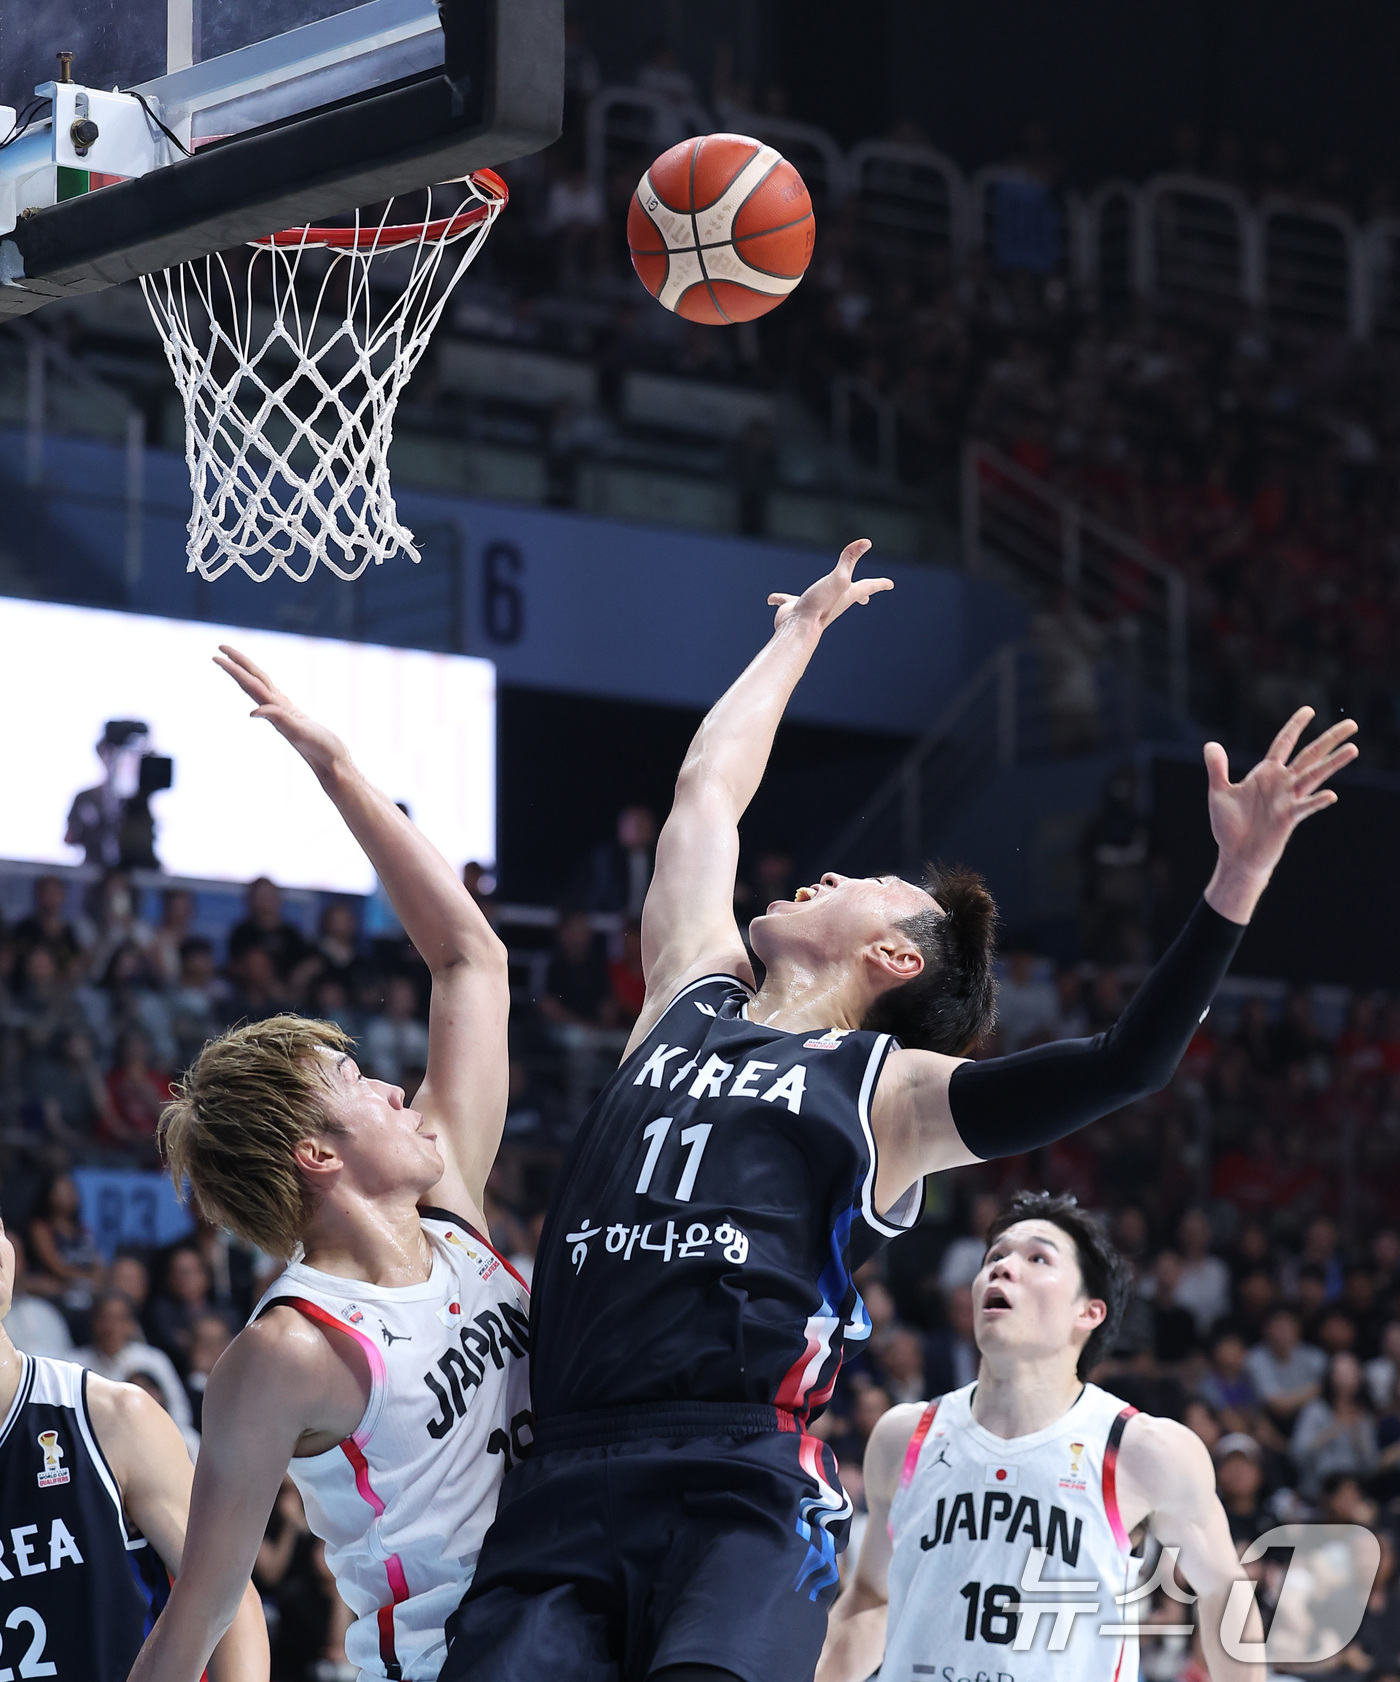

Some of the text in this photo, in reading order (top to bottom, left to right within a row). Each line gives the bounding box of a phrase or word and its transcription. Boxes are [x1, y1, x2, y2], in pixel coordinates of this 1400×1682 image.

[482, 539, 524, 646] 6
[634, 1116, 713, 1202] 11
[605, 1220, 749, 1264] 하나은행
[920, 1491, 1083, 1568] JAPAN
[0, 1605, 58, 1682] 2
[960, 1581, 1021, 1645] 18
